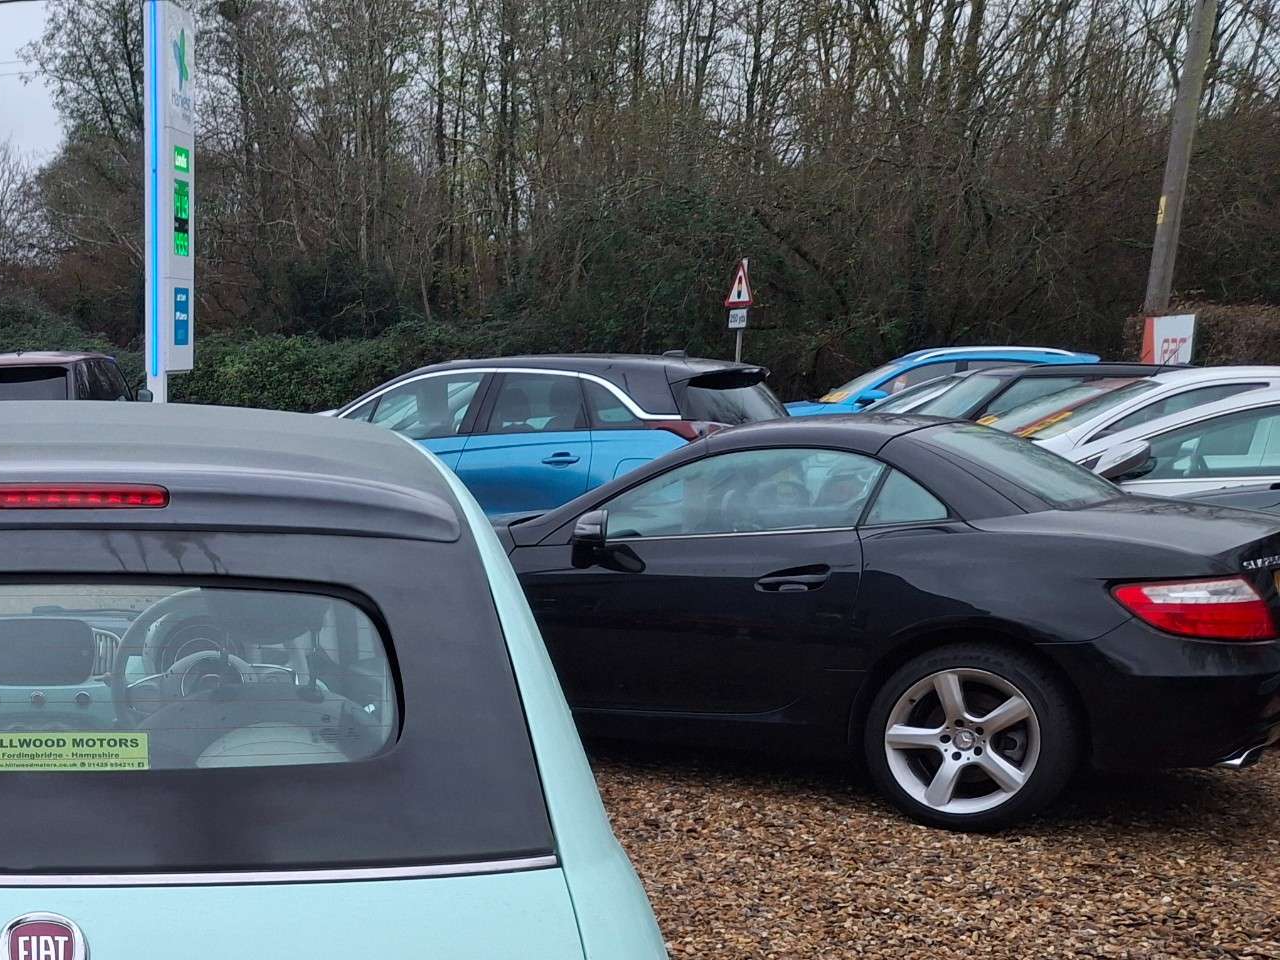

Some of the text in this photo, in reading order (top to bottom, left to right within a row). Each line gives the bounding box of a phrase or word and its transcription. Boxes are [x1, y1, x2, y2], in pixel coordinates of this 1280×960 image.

[72, 738, 140, 748] MOTORS
[1, 751, 64, 761] Fordingbridge
[71, 751, 120, 760] Hampshire
